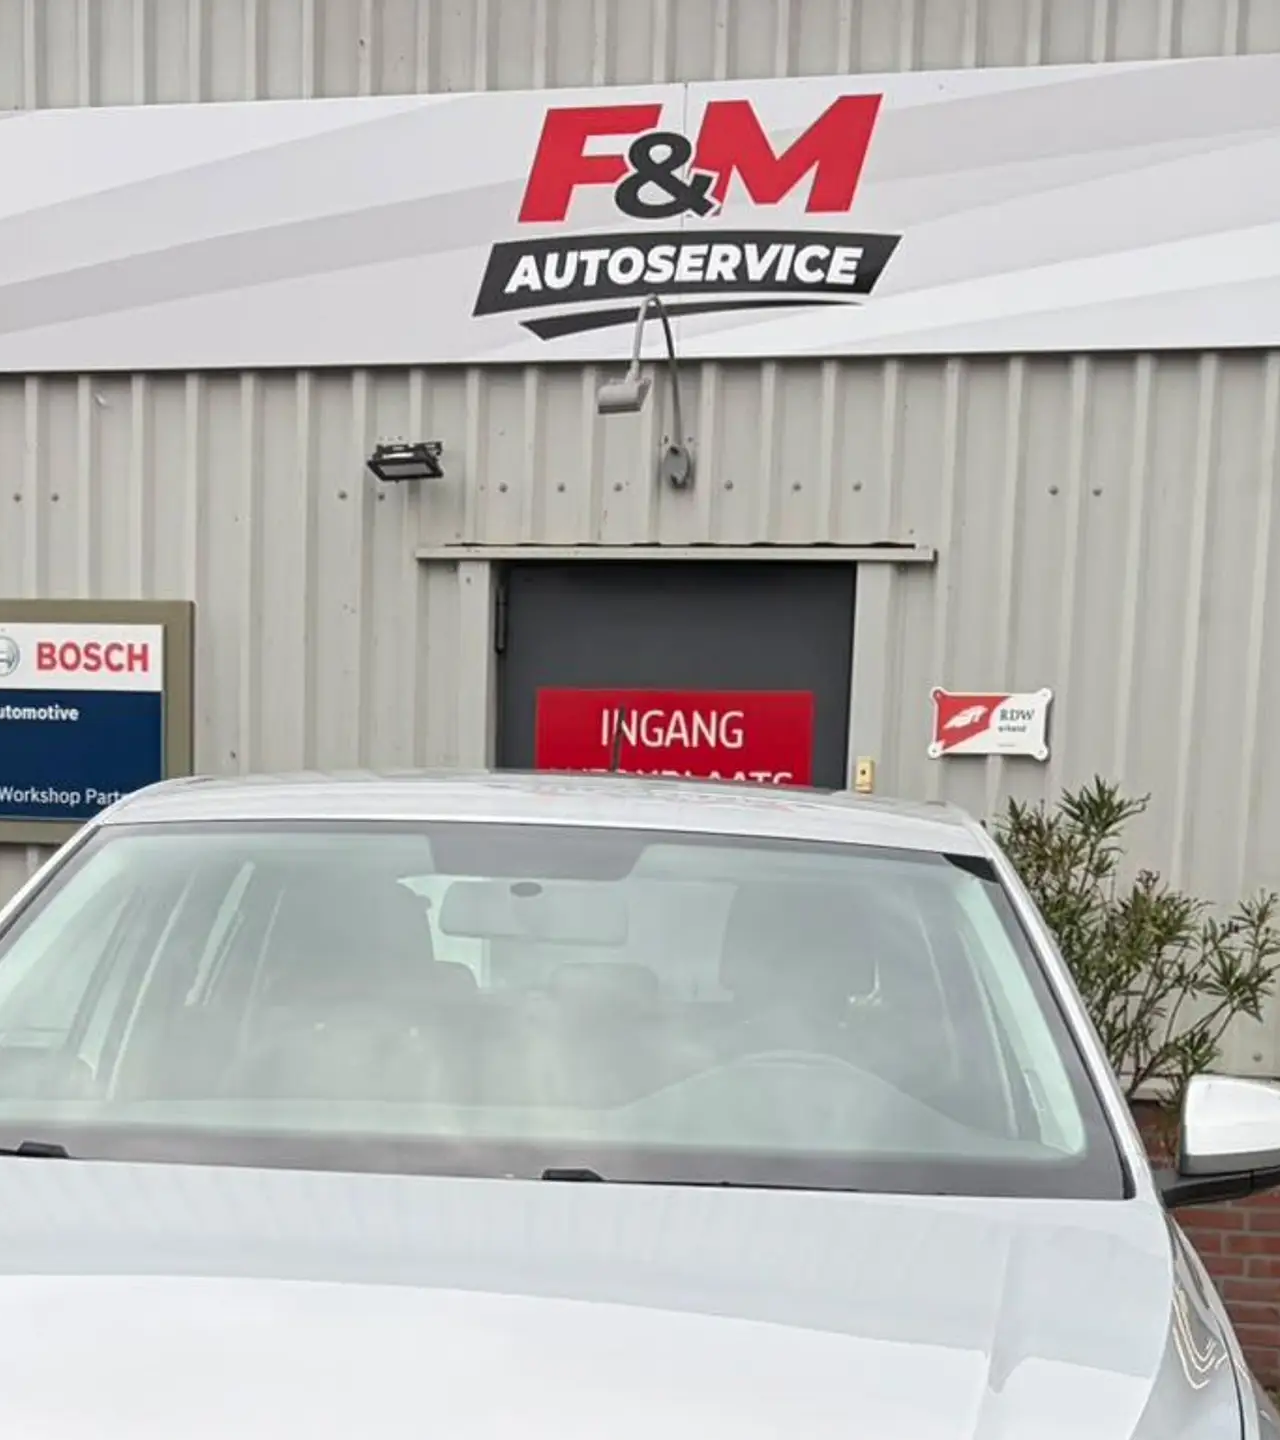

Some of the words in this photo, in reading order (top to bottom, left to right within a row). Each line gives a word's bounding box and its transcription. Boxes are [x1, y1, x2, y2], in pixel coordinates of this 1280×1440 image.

[518, 94, 883, 222] F&M
[505, 244, 863, 293] AUTOSERVICE
[36, 642, 149, 672] BOSCH
[601, 708, 744, 748] INGANG
[86, 788, 126, 805] Part
